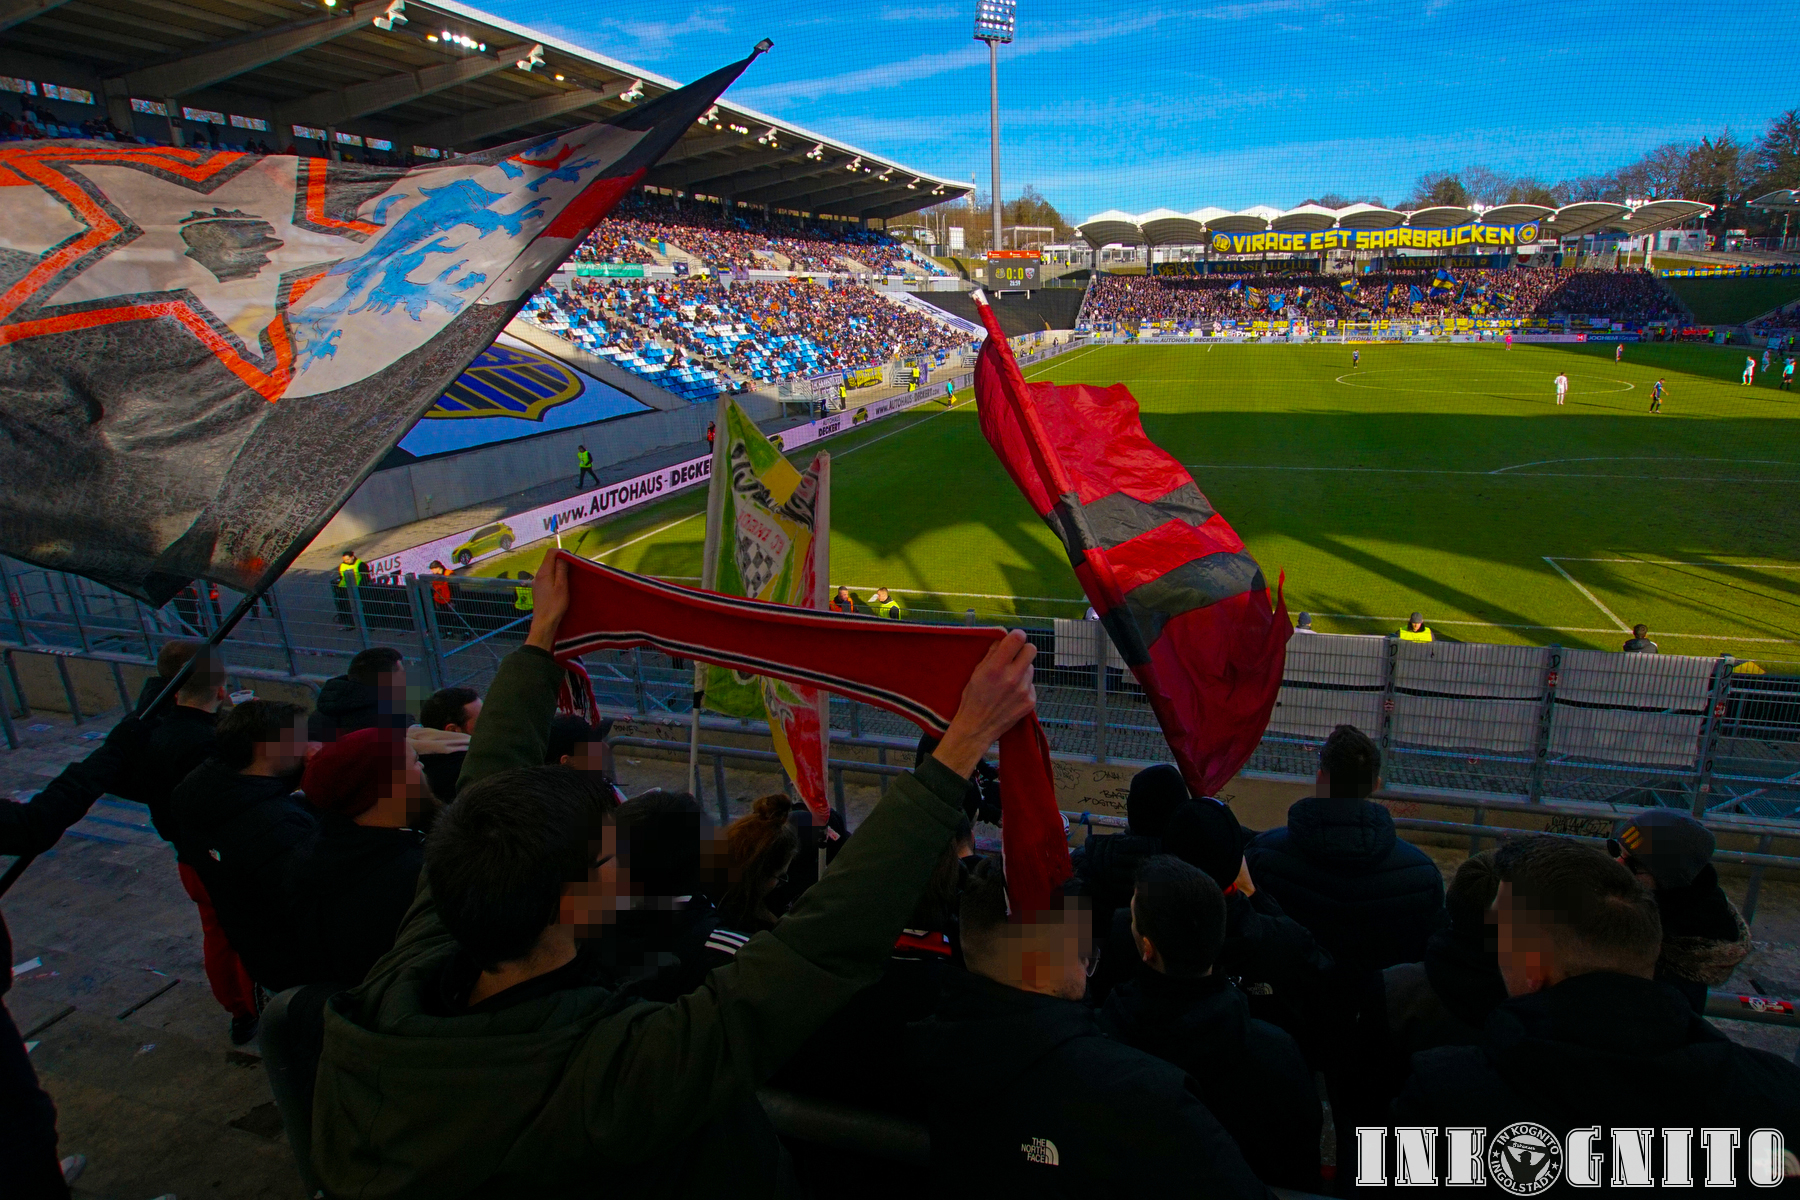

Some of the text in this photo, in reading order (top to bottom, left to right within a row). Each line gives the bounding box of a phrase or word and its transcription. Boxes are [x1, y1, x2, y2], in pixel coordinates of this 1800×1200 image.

[1233, 231, 1306, 253] VIRAGE
[1310, 230, 1351, 250] EST
[818, 421, 841, 437] DECKERT
[1032, 1137, 1046, 1147] THE
[1021, 1143, 1046, 1155] NORTH
[1027, 1152, 1045, 1164] FACE
